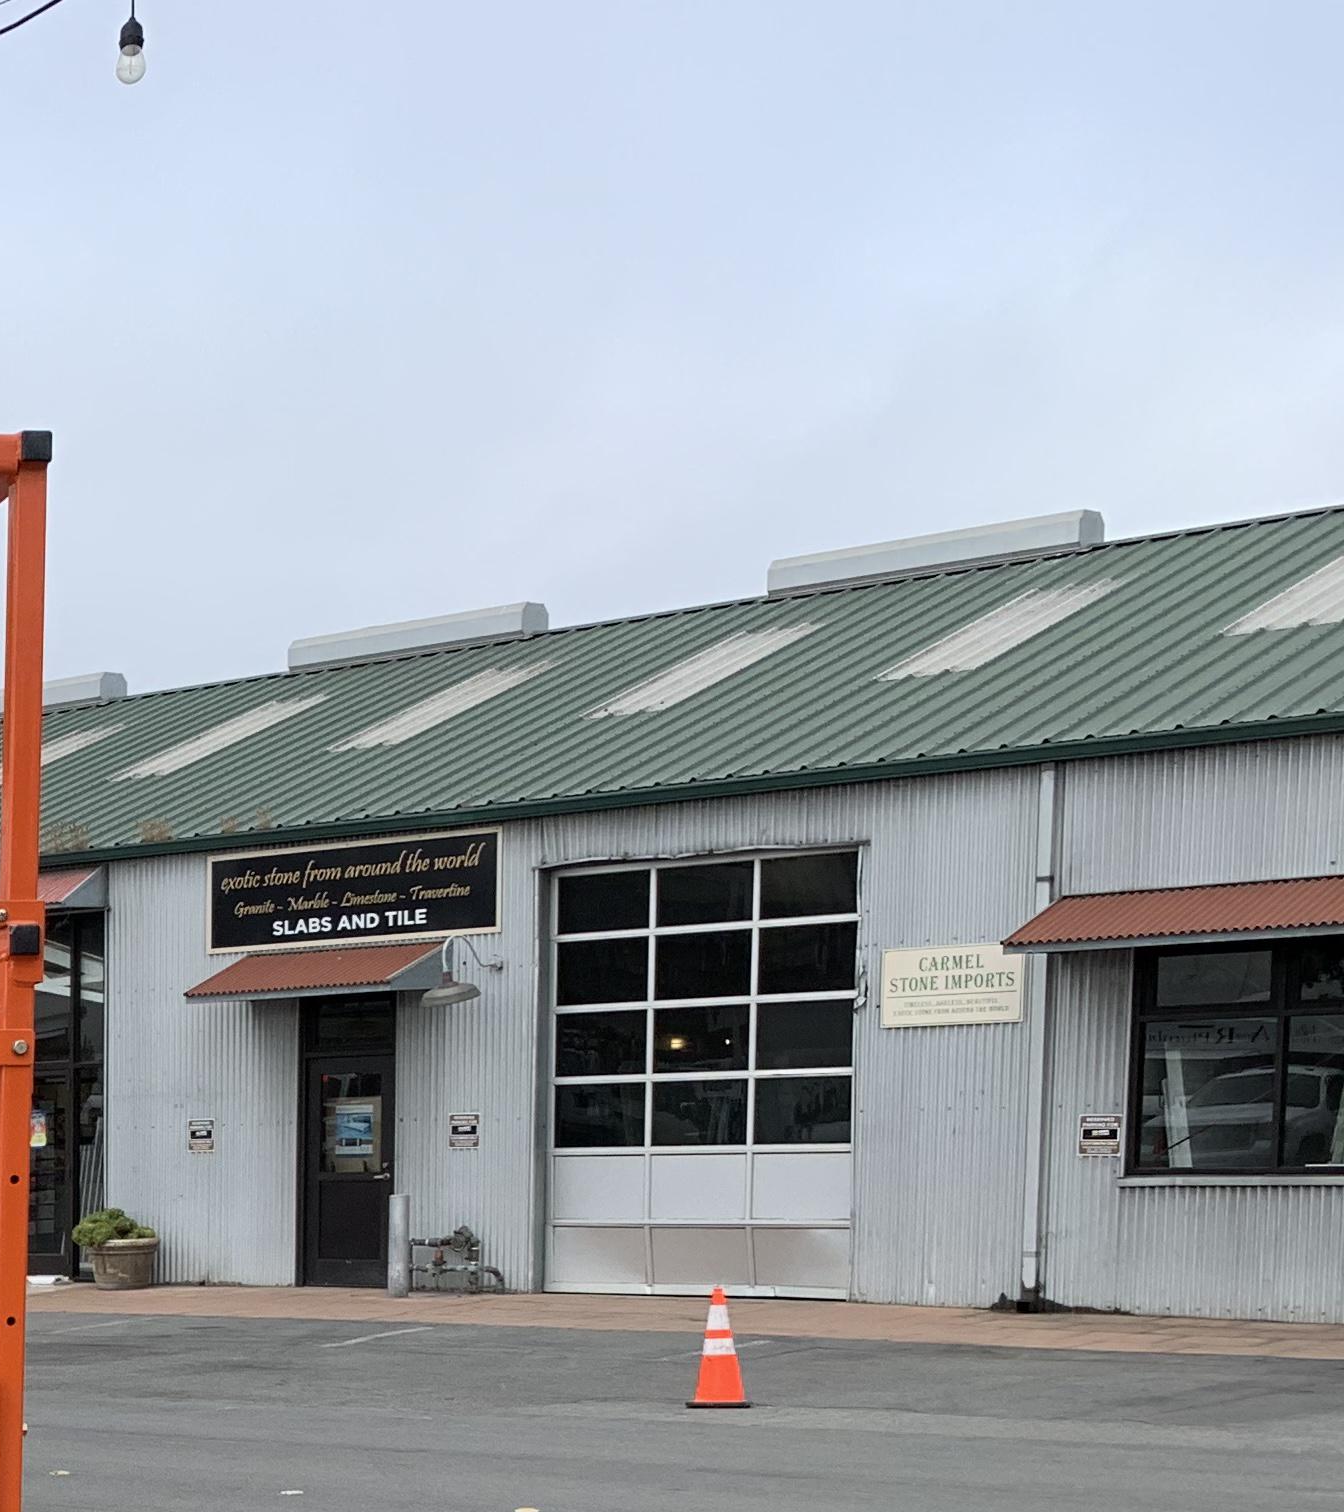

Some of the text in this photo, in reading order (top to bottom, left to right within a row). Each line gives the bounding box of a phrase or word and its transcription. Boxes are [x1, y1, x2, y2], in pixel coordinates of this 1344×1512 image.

[221, 842, 486, 894] exotic stone from around the world
[234, 901, 275, 918] Granite
[287, 892, 330, 912] Marble
[340, 890, 397, 907] Limestone
[409, 883, 471, 900] Travertine
[272, 908, 428, 936] SLABS AND TILE
[919, 954, 984, 972] CARMEL
[889, 972, 1015, 992] STONE IMPORTS
